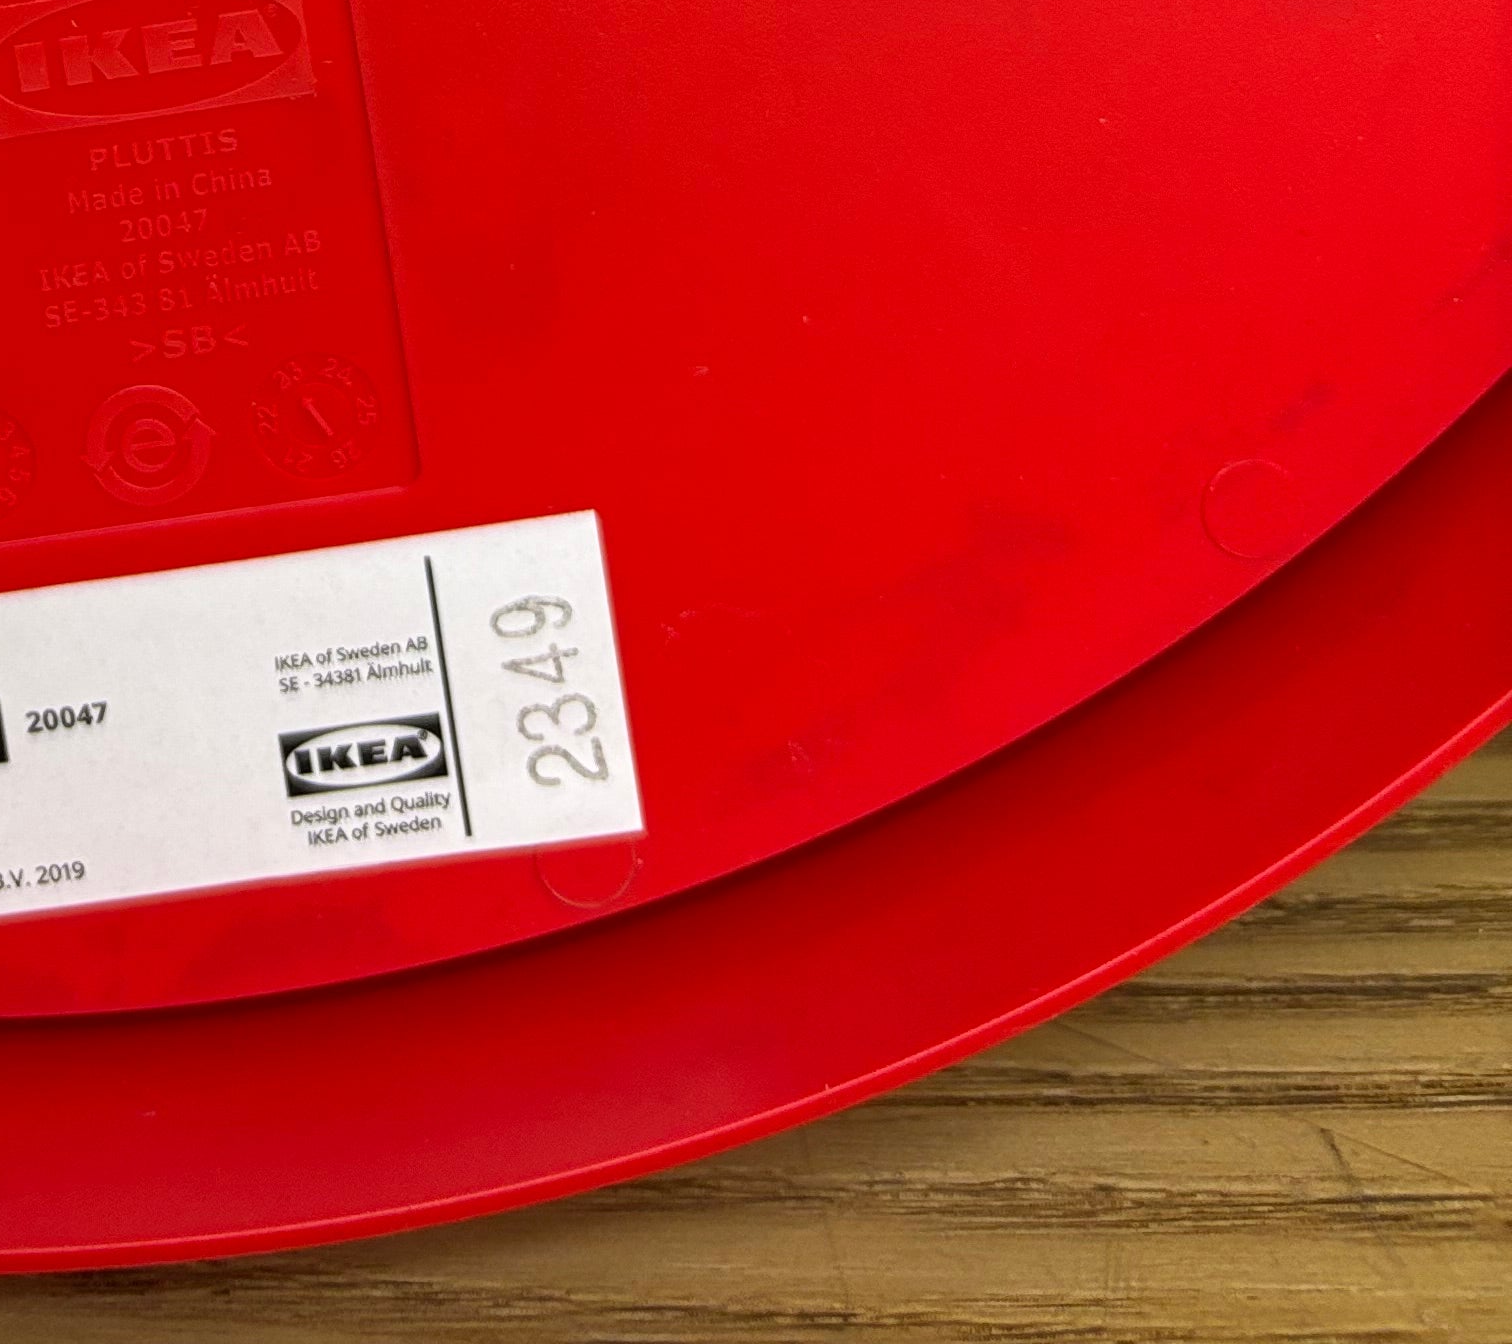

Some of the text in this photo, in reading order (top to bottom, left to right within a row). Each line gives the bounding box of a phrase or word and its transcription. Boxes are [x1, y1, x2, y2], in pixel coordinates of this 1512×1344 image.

[14, 9, 284, 93] IKEA
[89, 128, 238, 171] PLUTTIS
[67, 167, 272, 214] Made in China
[119, 209, 209, 243] 20047
[39, 229, 321, 292] IKEA of Sweden AB
[274, 636, 428, 672] IKEA of Sweden AB
[279, 676, 300, 693] SE
[314, 669, 362, 689] 34381
[367, 658, 433, 681] Älmhult
[490, 594, 609, 787] 2349
[26, 701, 108, 733] 20047
[294, 731, 428, 776] IKEA
[291, 791, 451, 827] Design and Quality
[308, 814, 442, 846] IKEA of Sweden
[36, 860, 85, 885] 2019
